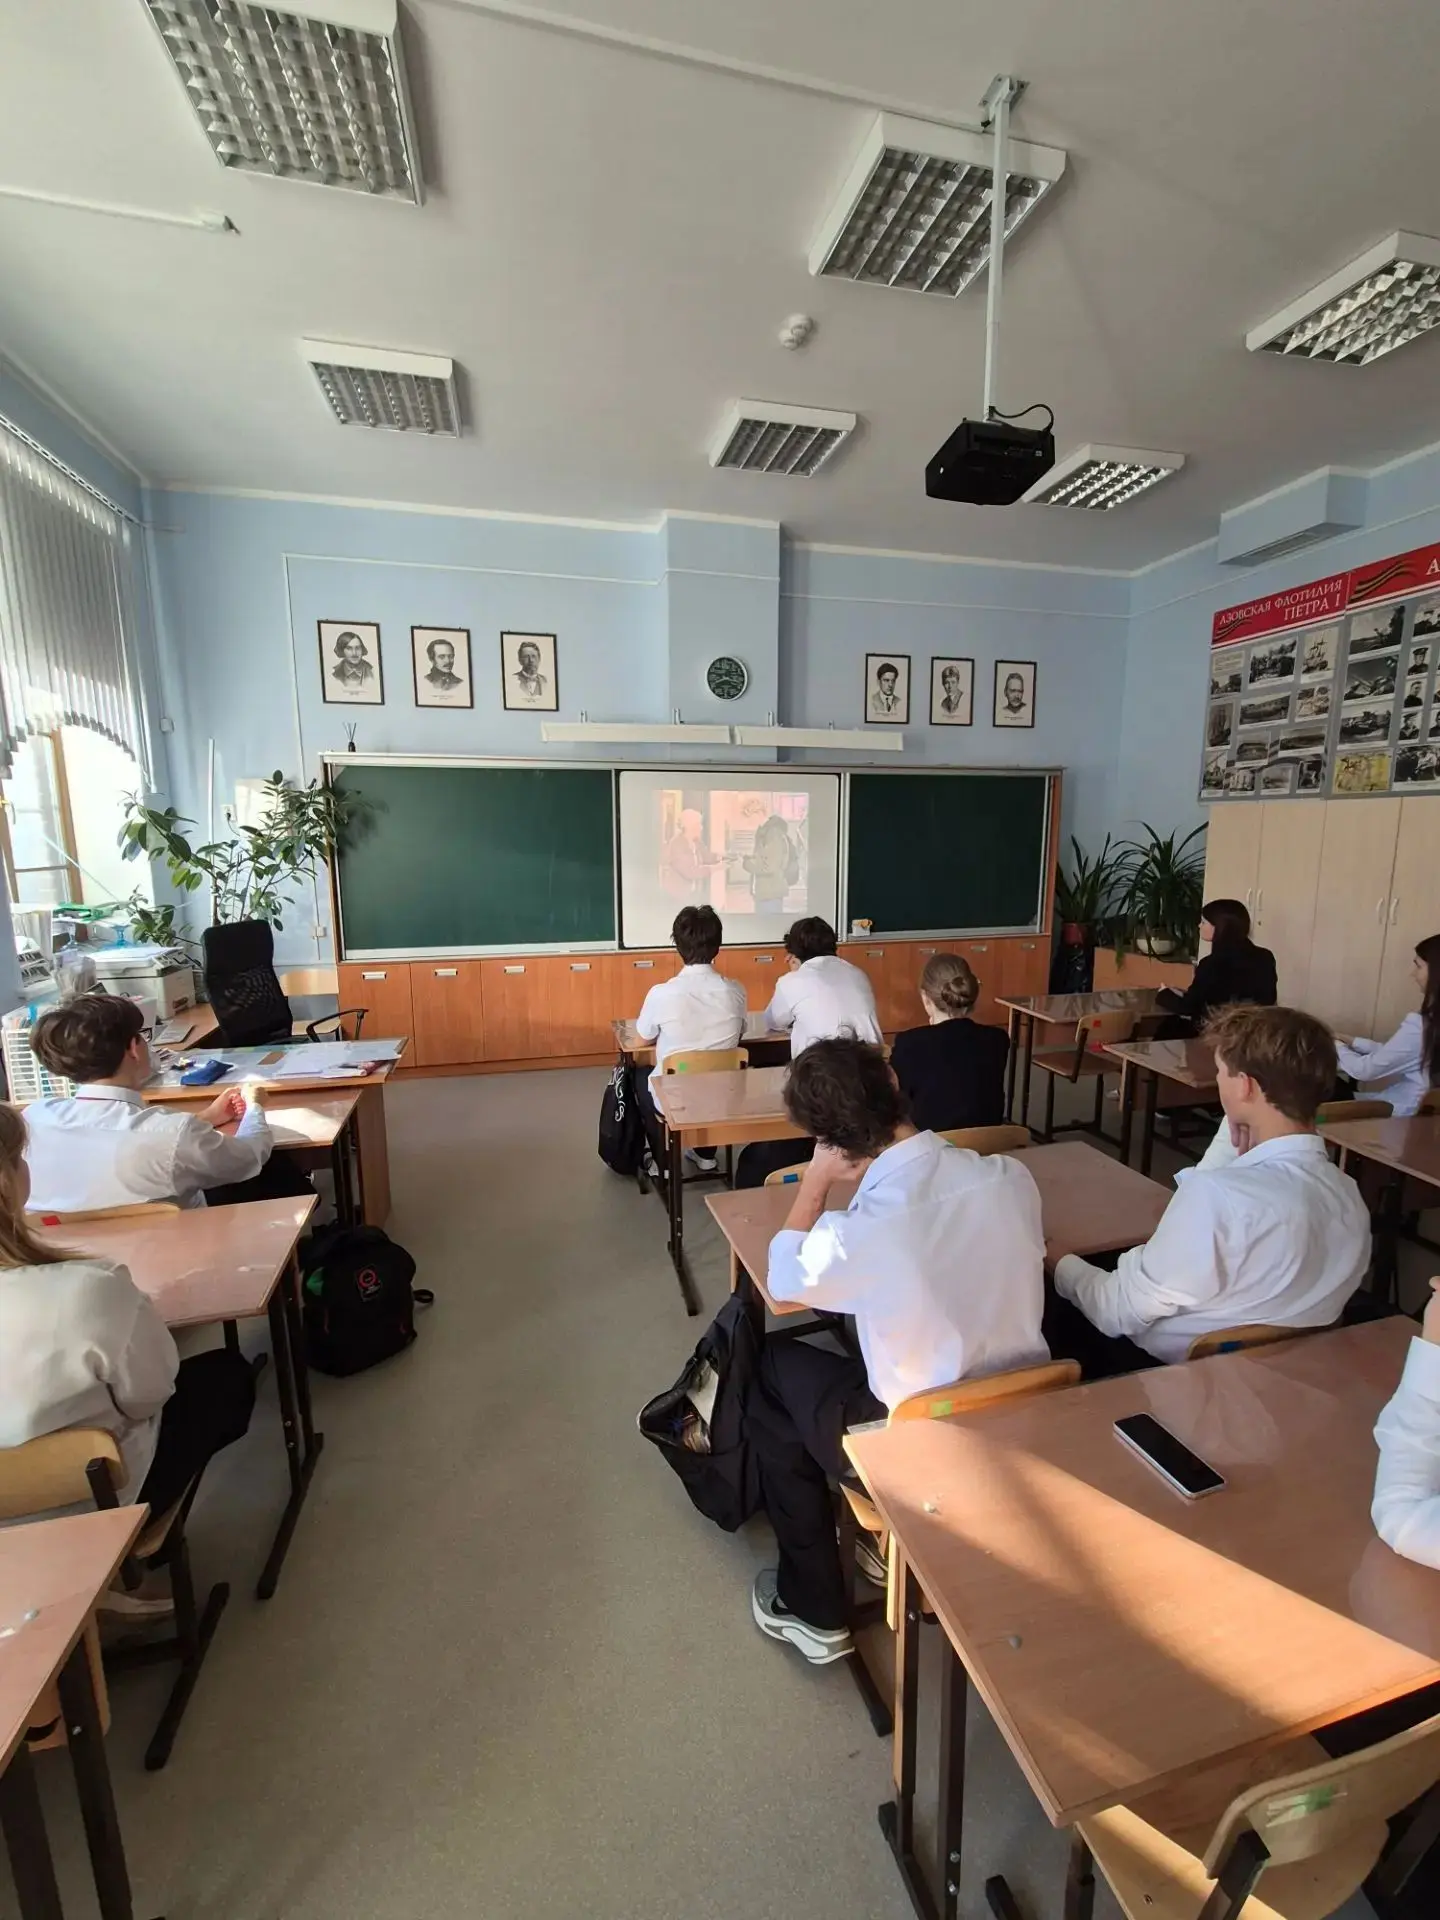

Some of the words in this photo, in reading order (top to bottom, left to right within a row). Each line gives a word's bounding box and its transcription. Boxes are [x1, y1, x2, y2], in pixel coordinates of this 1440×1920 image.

[1219, 601, 1271, 625] АЗОВСКАЯ
[1274, 580, 1342, 608] ФЛОТИЛИЯ
[1284, 598, 1329, 620] ПЕТРА
